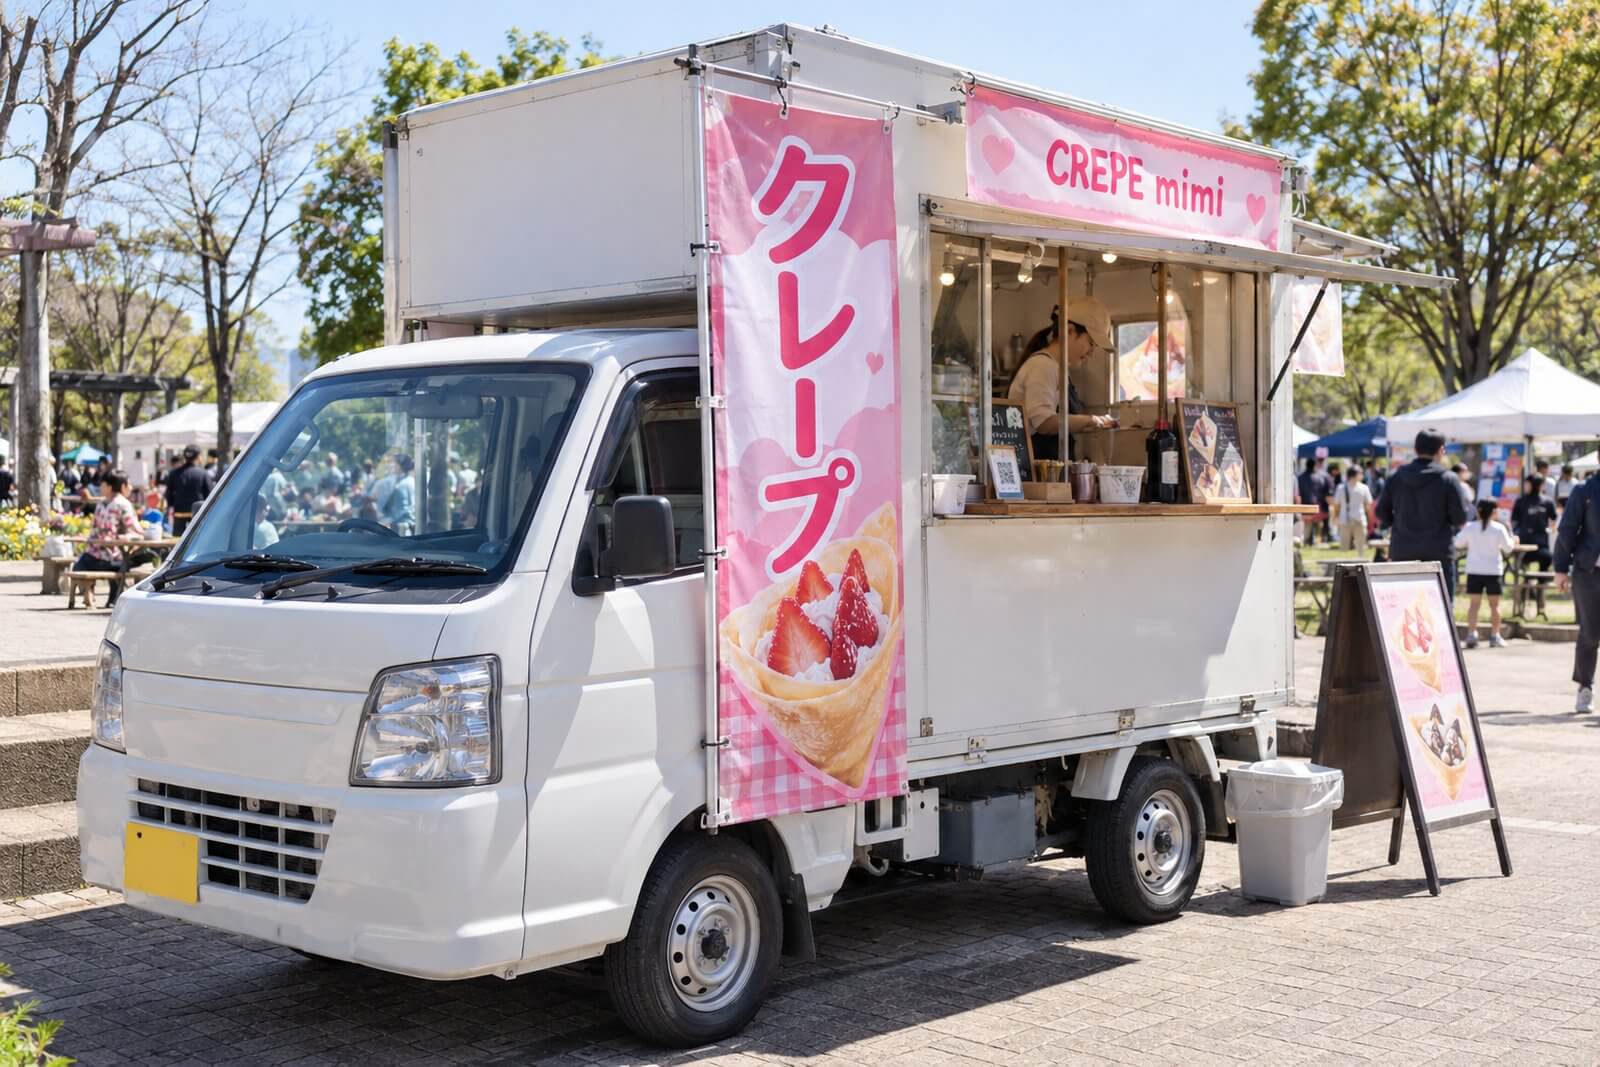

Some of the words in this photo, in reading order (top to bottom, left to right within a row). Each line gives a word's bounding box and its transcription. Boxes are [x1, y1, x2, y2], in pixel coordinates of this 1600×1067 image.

[1046, 139, 1144, 200] CREPE
[1155, 168, 1224, 217] mimi
[758, 144, 856, 574] クレープ
